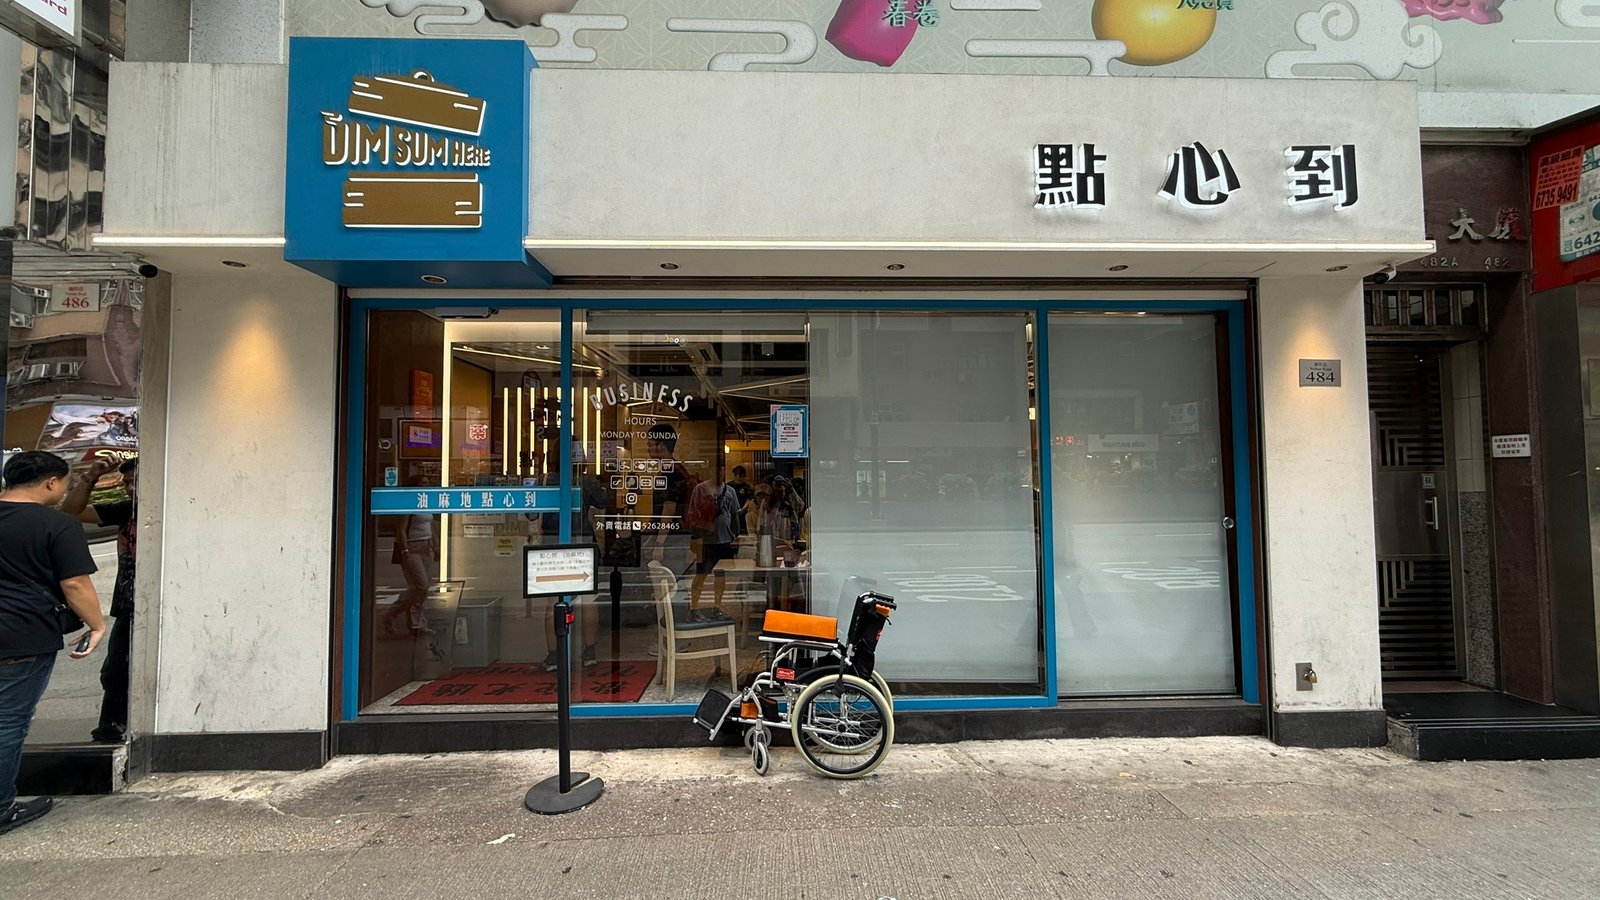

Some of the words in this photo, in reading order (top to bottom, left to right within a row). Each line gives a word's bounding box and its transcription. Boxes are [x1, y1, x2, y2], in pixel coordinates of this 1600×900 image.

[322, 113, 390, 166] DIM
[393, 126, 449, 166] SUM
[452, 140, 490, 166] HERE
[1034, 141, 1358, 208] 點心到
[1536, 189, 1556, 208] 6735
[1557, 182, 1578, 205] 9491
[1420, 257, 1459, 267] 482A
[62, 297, 89, 308] 486
[1306, 371, 1335, 383] 484
[589, 382, 693, 412] BUSINESS
[624, 417, 657, 425] HOURS
[600, 431, 635, 439] MONDAY
[636, 431, 647, 439] TO
[648, 431, 681, 439] SUNDAY
[417, 491, 536, 508] 油麻地點心到
[596, 521, 631, 530] 外賣電話
[642, 522, 680, 530] 52628465
